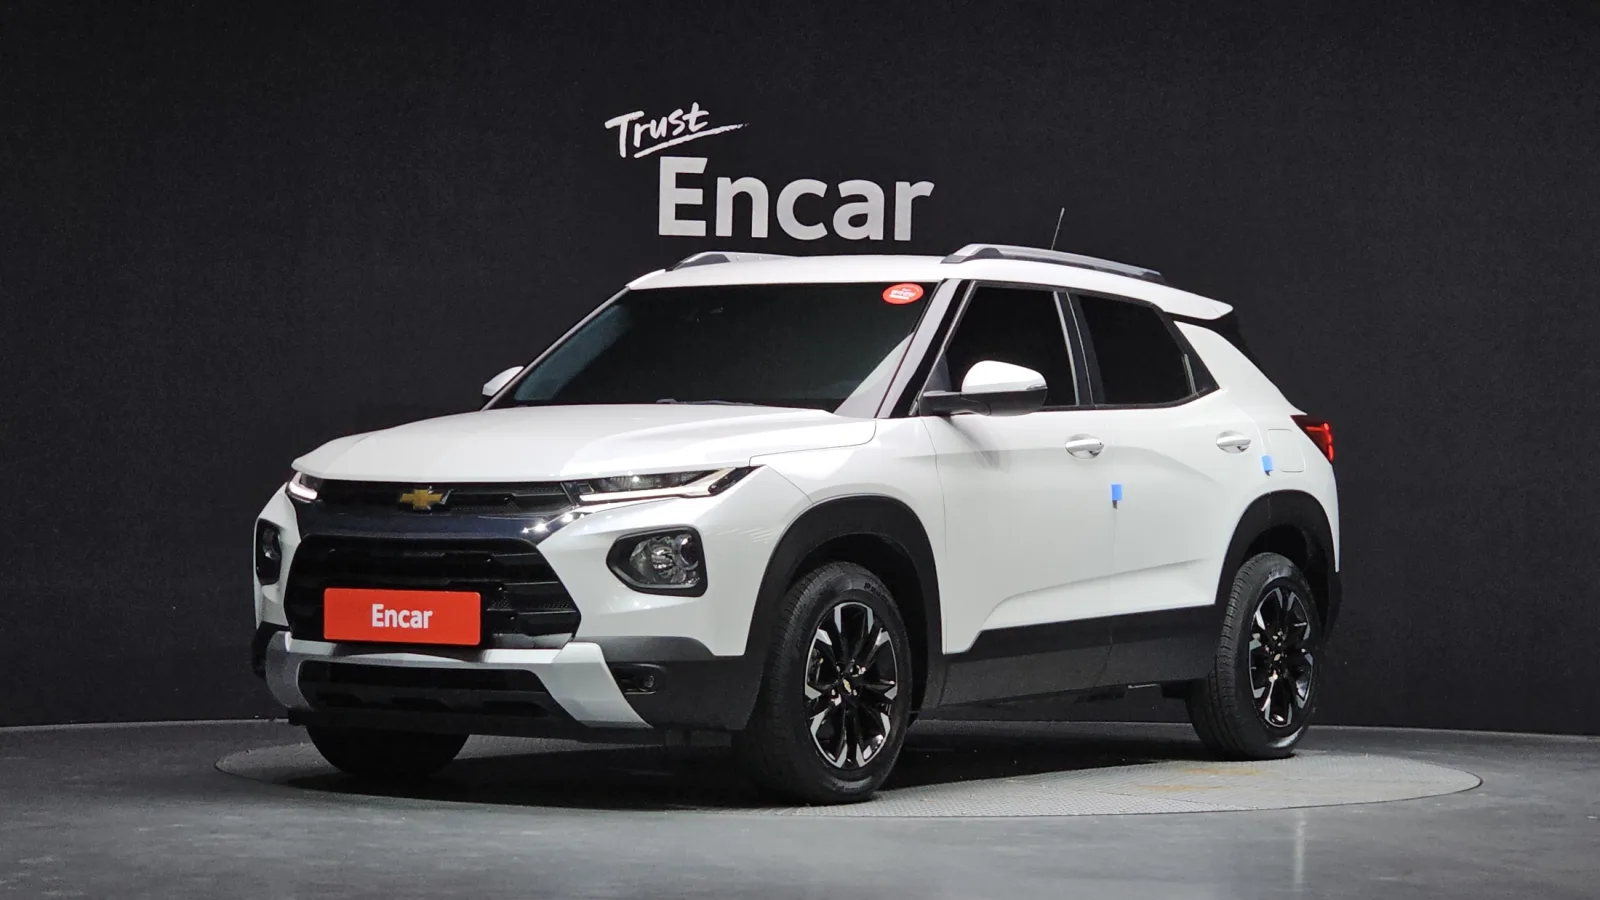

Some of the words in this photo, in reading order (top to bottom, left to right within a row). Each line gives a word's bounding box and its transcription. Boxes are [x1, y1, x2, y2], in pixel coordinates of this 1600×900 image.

[604, 101, 712, 158] Trust
[658, 156, 935, 241] Encar
[371, 603, 433, 630] Encar
